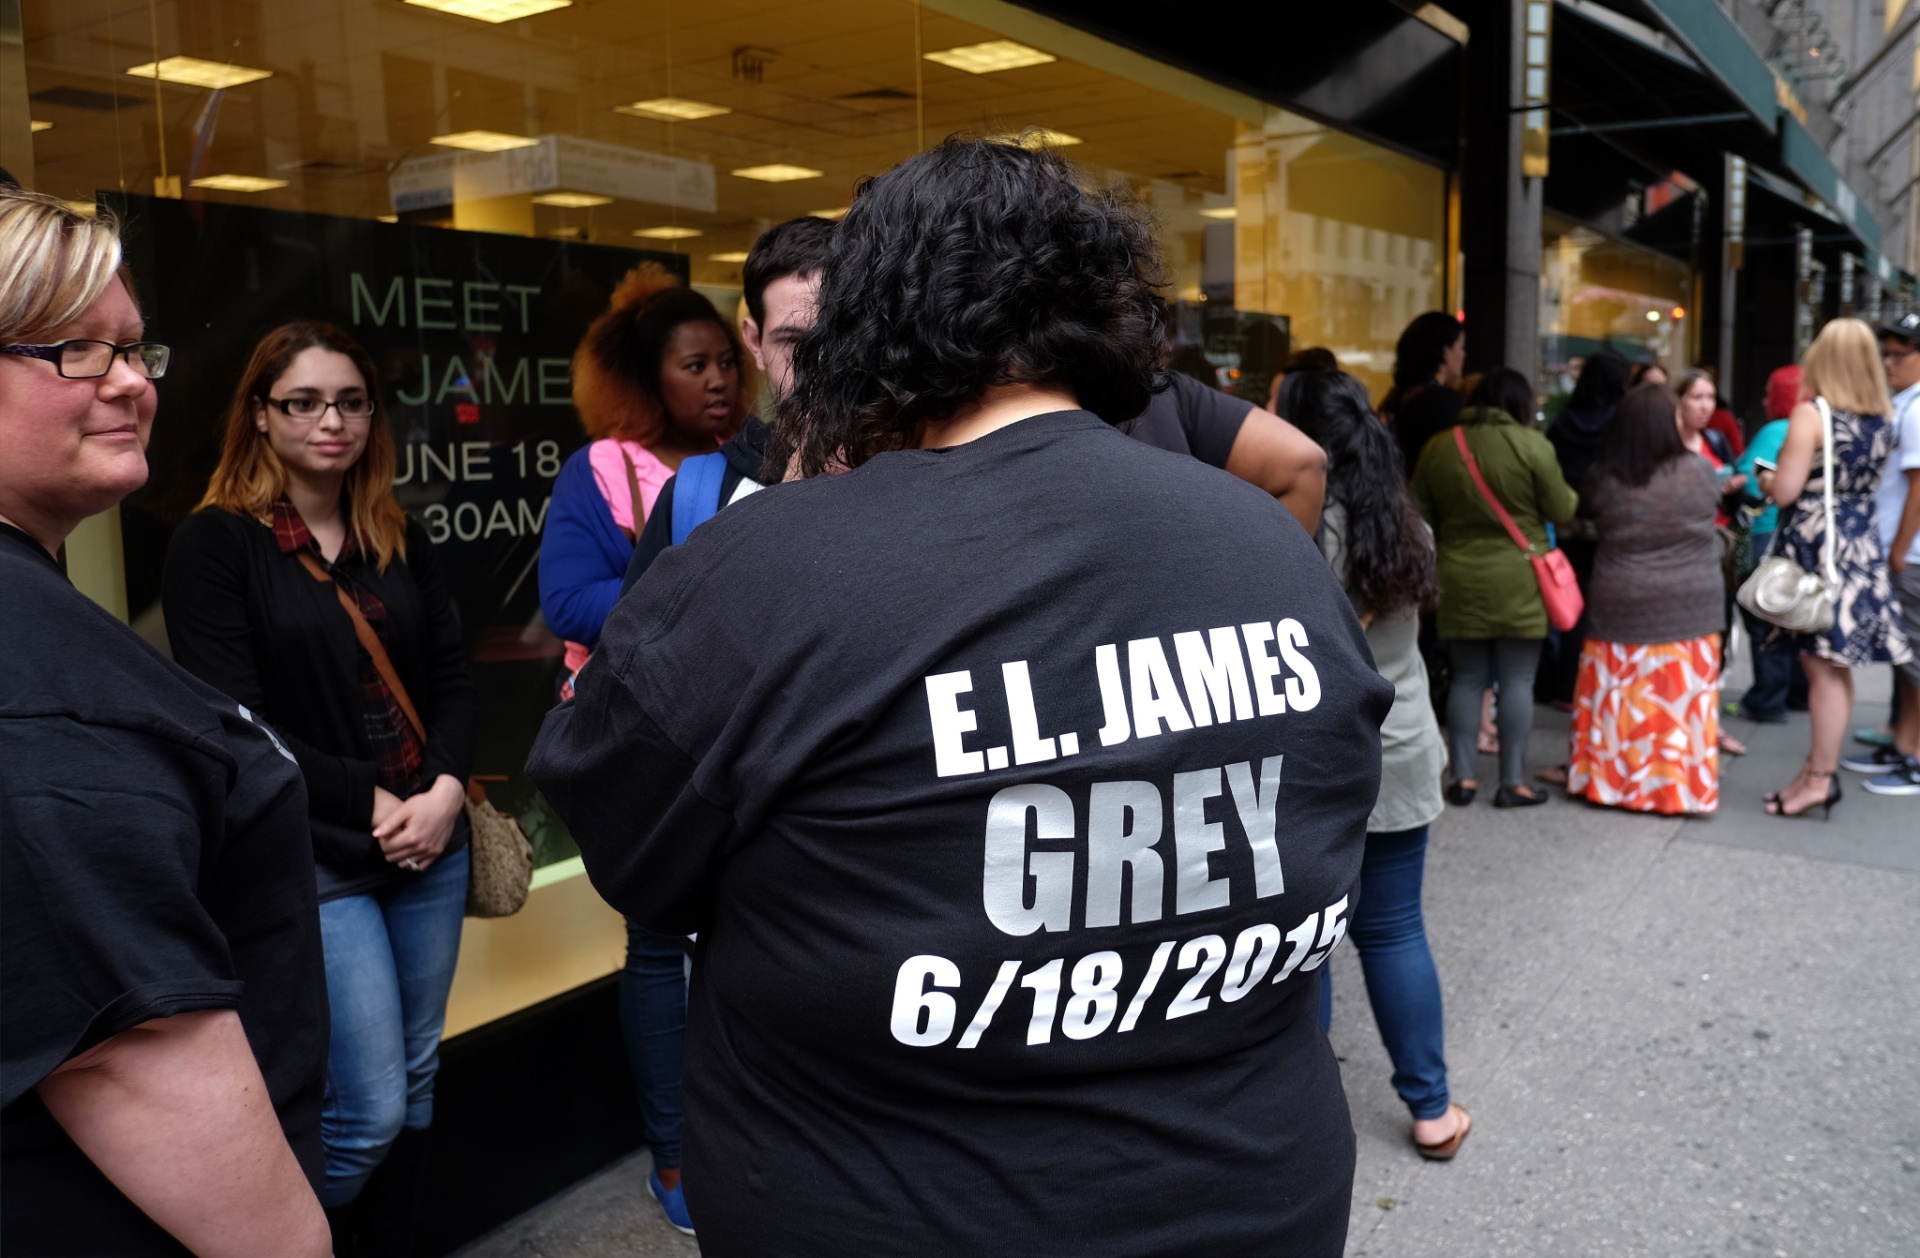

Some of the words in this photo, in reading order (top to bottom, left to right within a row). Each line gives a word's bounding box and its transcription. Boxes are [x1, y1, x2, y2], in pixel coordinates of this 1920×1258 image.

[351, 272, 541, 333] MEET
[396, 354, 574, 405] JAME
[392, 441, 493, 485] UNE
[512, 440, 560, 478] 18
[423, 496, 552, 544] 30AM
[924, 660, 1080, 777] E.L.
[1096, 618, 1322, 747] JAMES
[983, 755, 1285, 937] GREY
[890, 893, 1349, 1049] 6/18/2015
